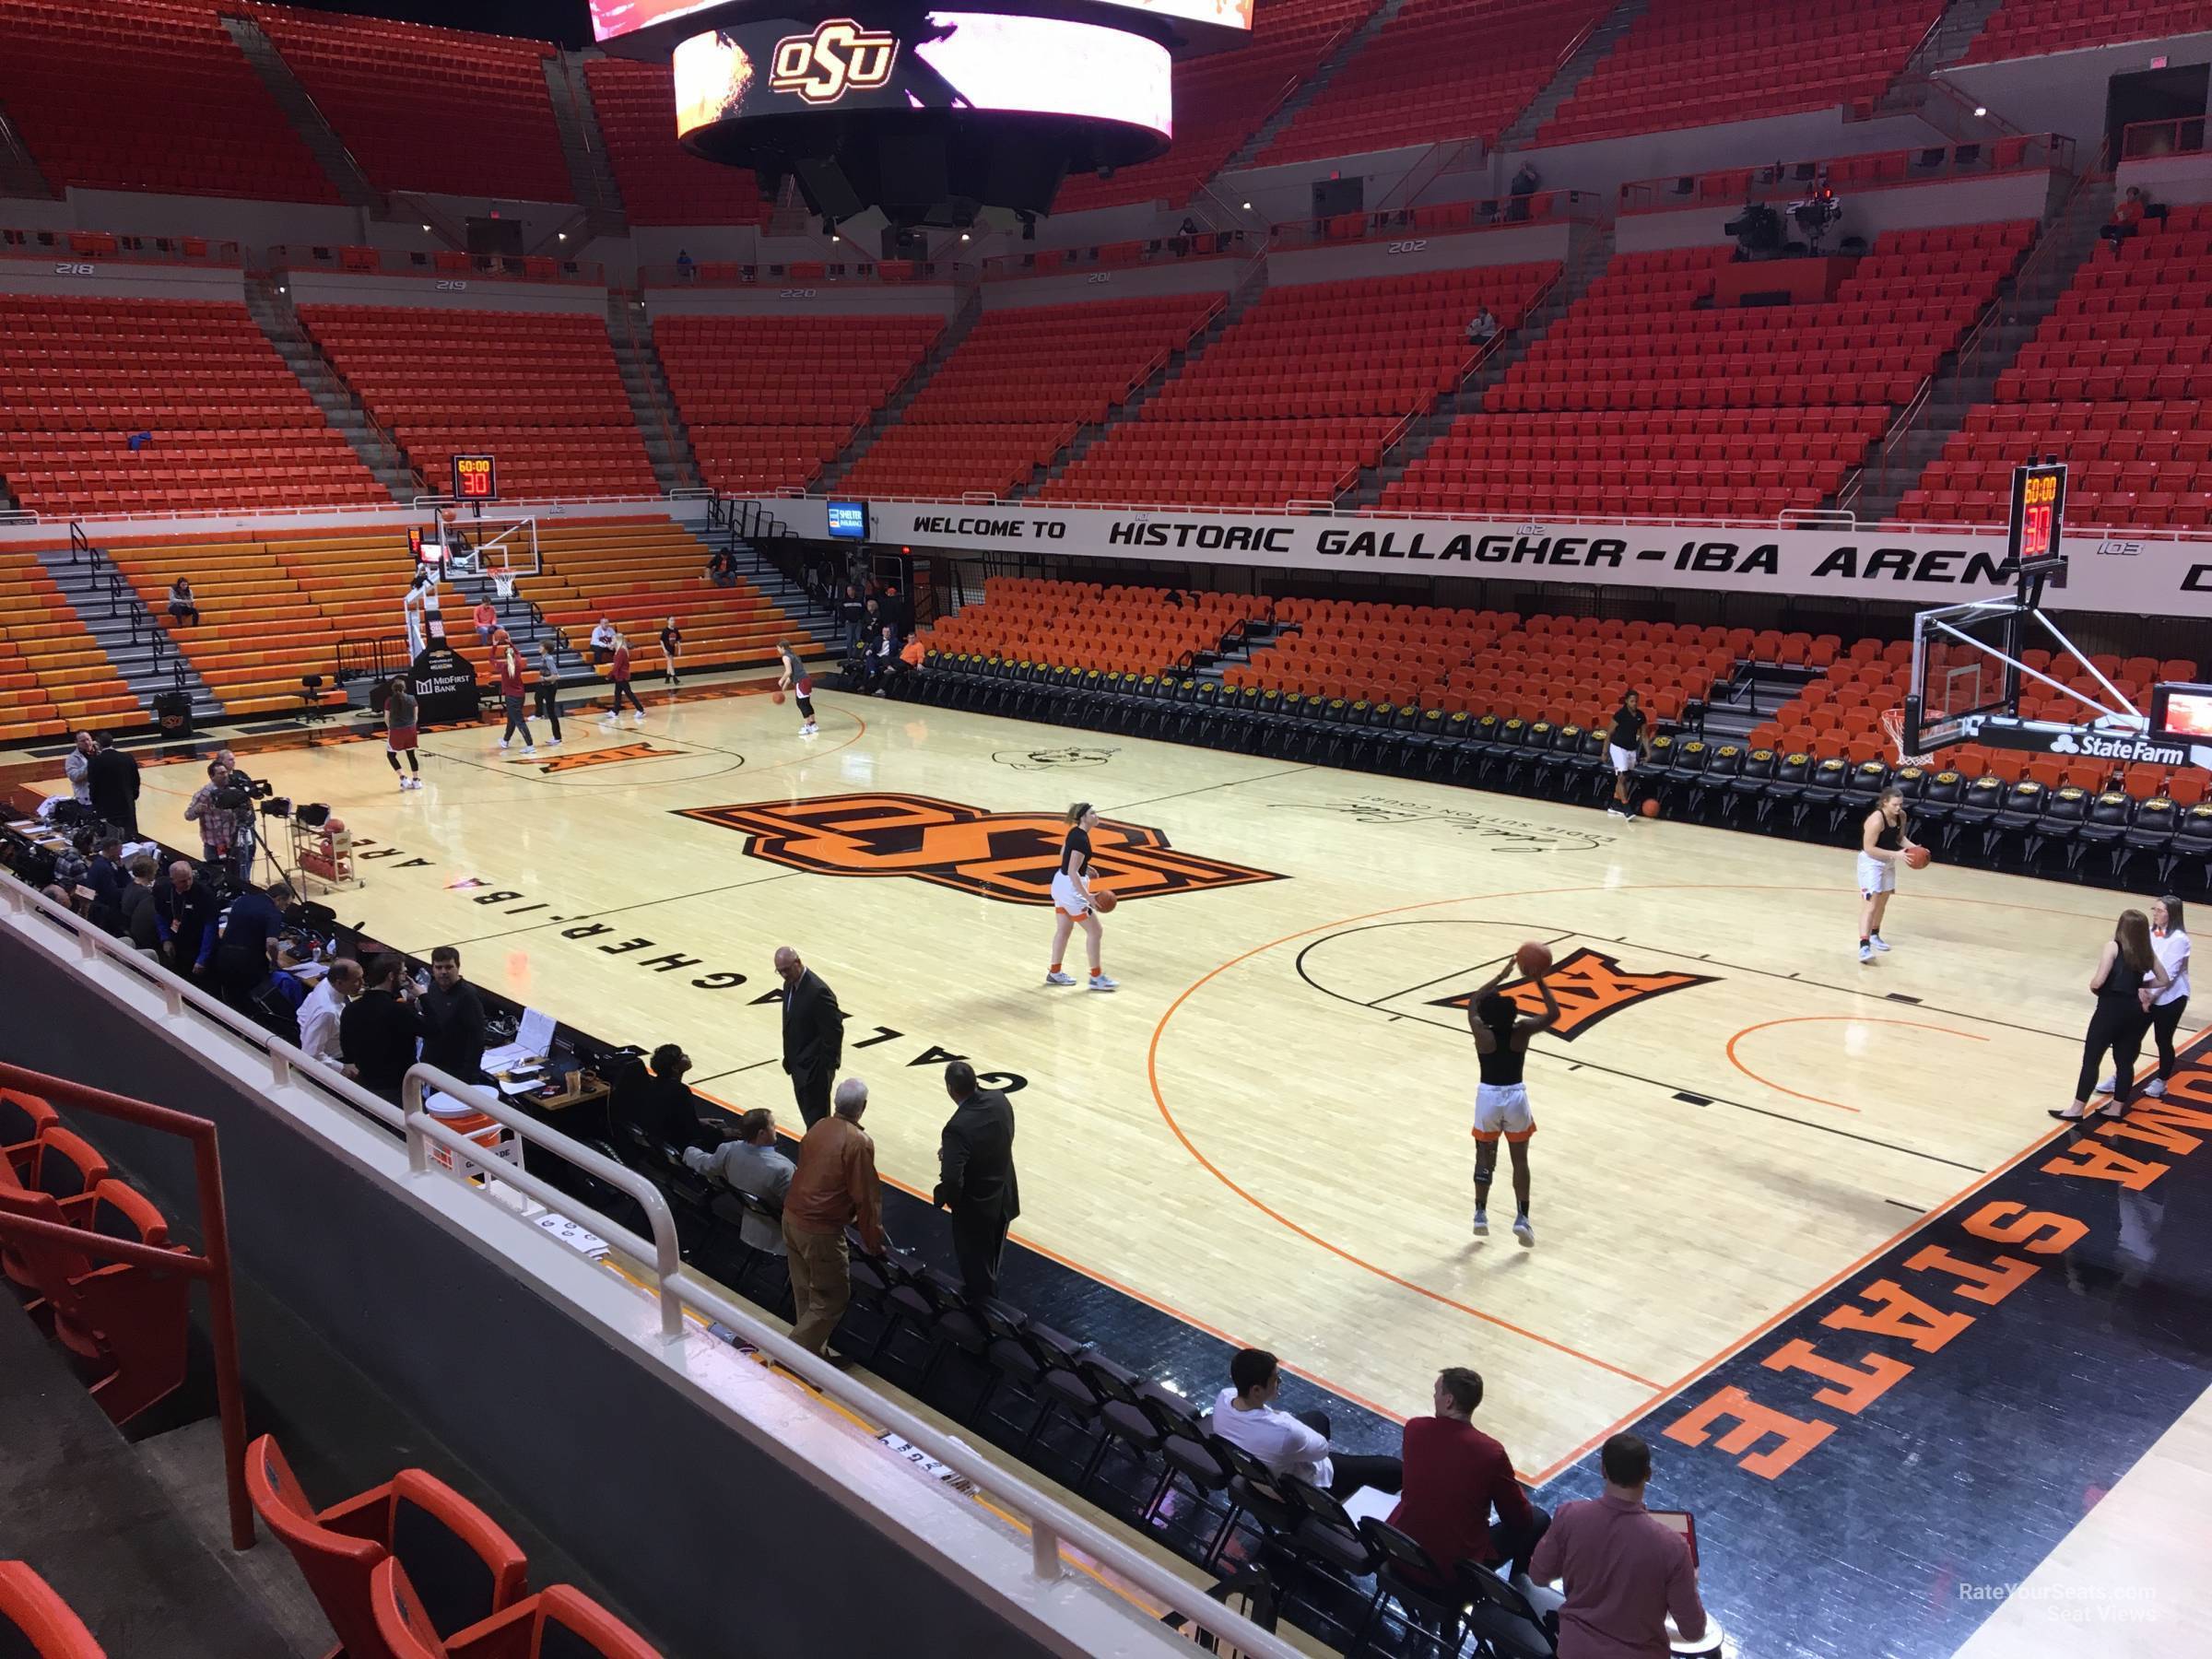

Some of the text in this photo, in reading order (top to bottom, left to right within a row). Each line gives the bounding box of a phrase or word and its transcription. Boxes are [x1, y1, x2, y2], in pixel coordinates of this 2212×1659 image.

[771, 20, 899, 102] OSU
[1785, 196, 1841, 215] 23
[1388, 239, 1428, 254] 202
[54, 263, 96, 275] 218
[434, 280, 467, 291] 219
[780, 288, 818, 299] 220
[458, 460, 490, 473] 60:00
[463, 473, 488, 494] 30
[2025, 476, 2057, 504] 60:00
[840, 510, 863, 519] SHELTER
[912, 516, 1026, 537] WELCOME
[1032, 521, 1066, 539] TO
[1109, 522, 1294, 552] HISTORIC
[1516, 524, 1547, 535] 102
[2025, 506, 2050, 553] 30
[2097, 540, 2146, 556] 103
[1357, 795, 1431, 809] COURT
[1439, 809, 1533, 827] SUTTON
[1661, 1200, 2091, 1481] STATE
